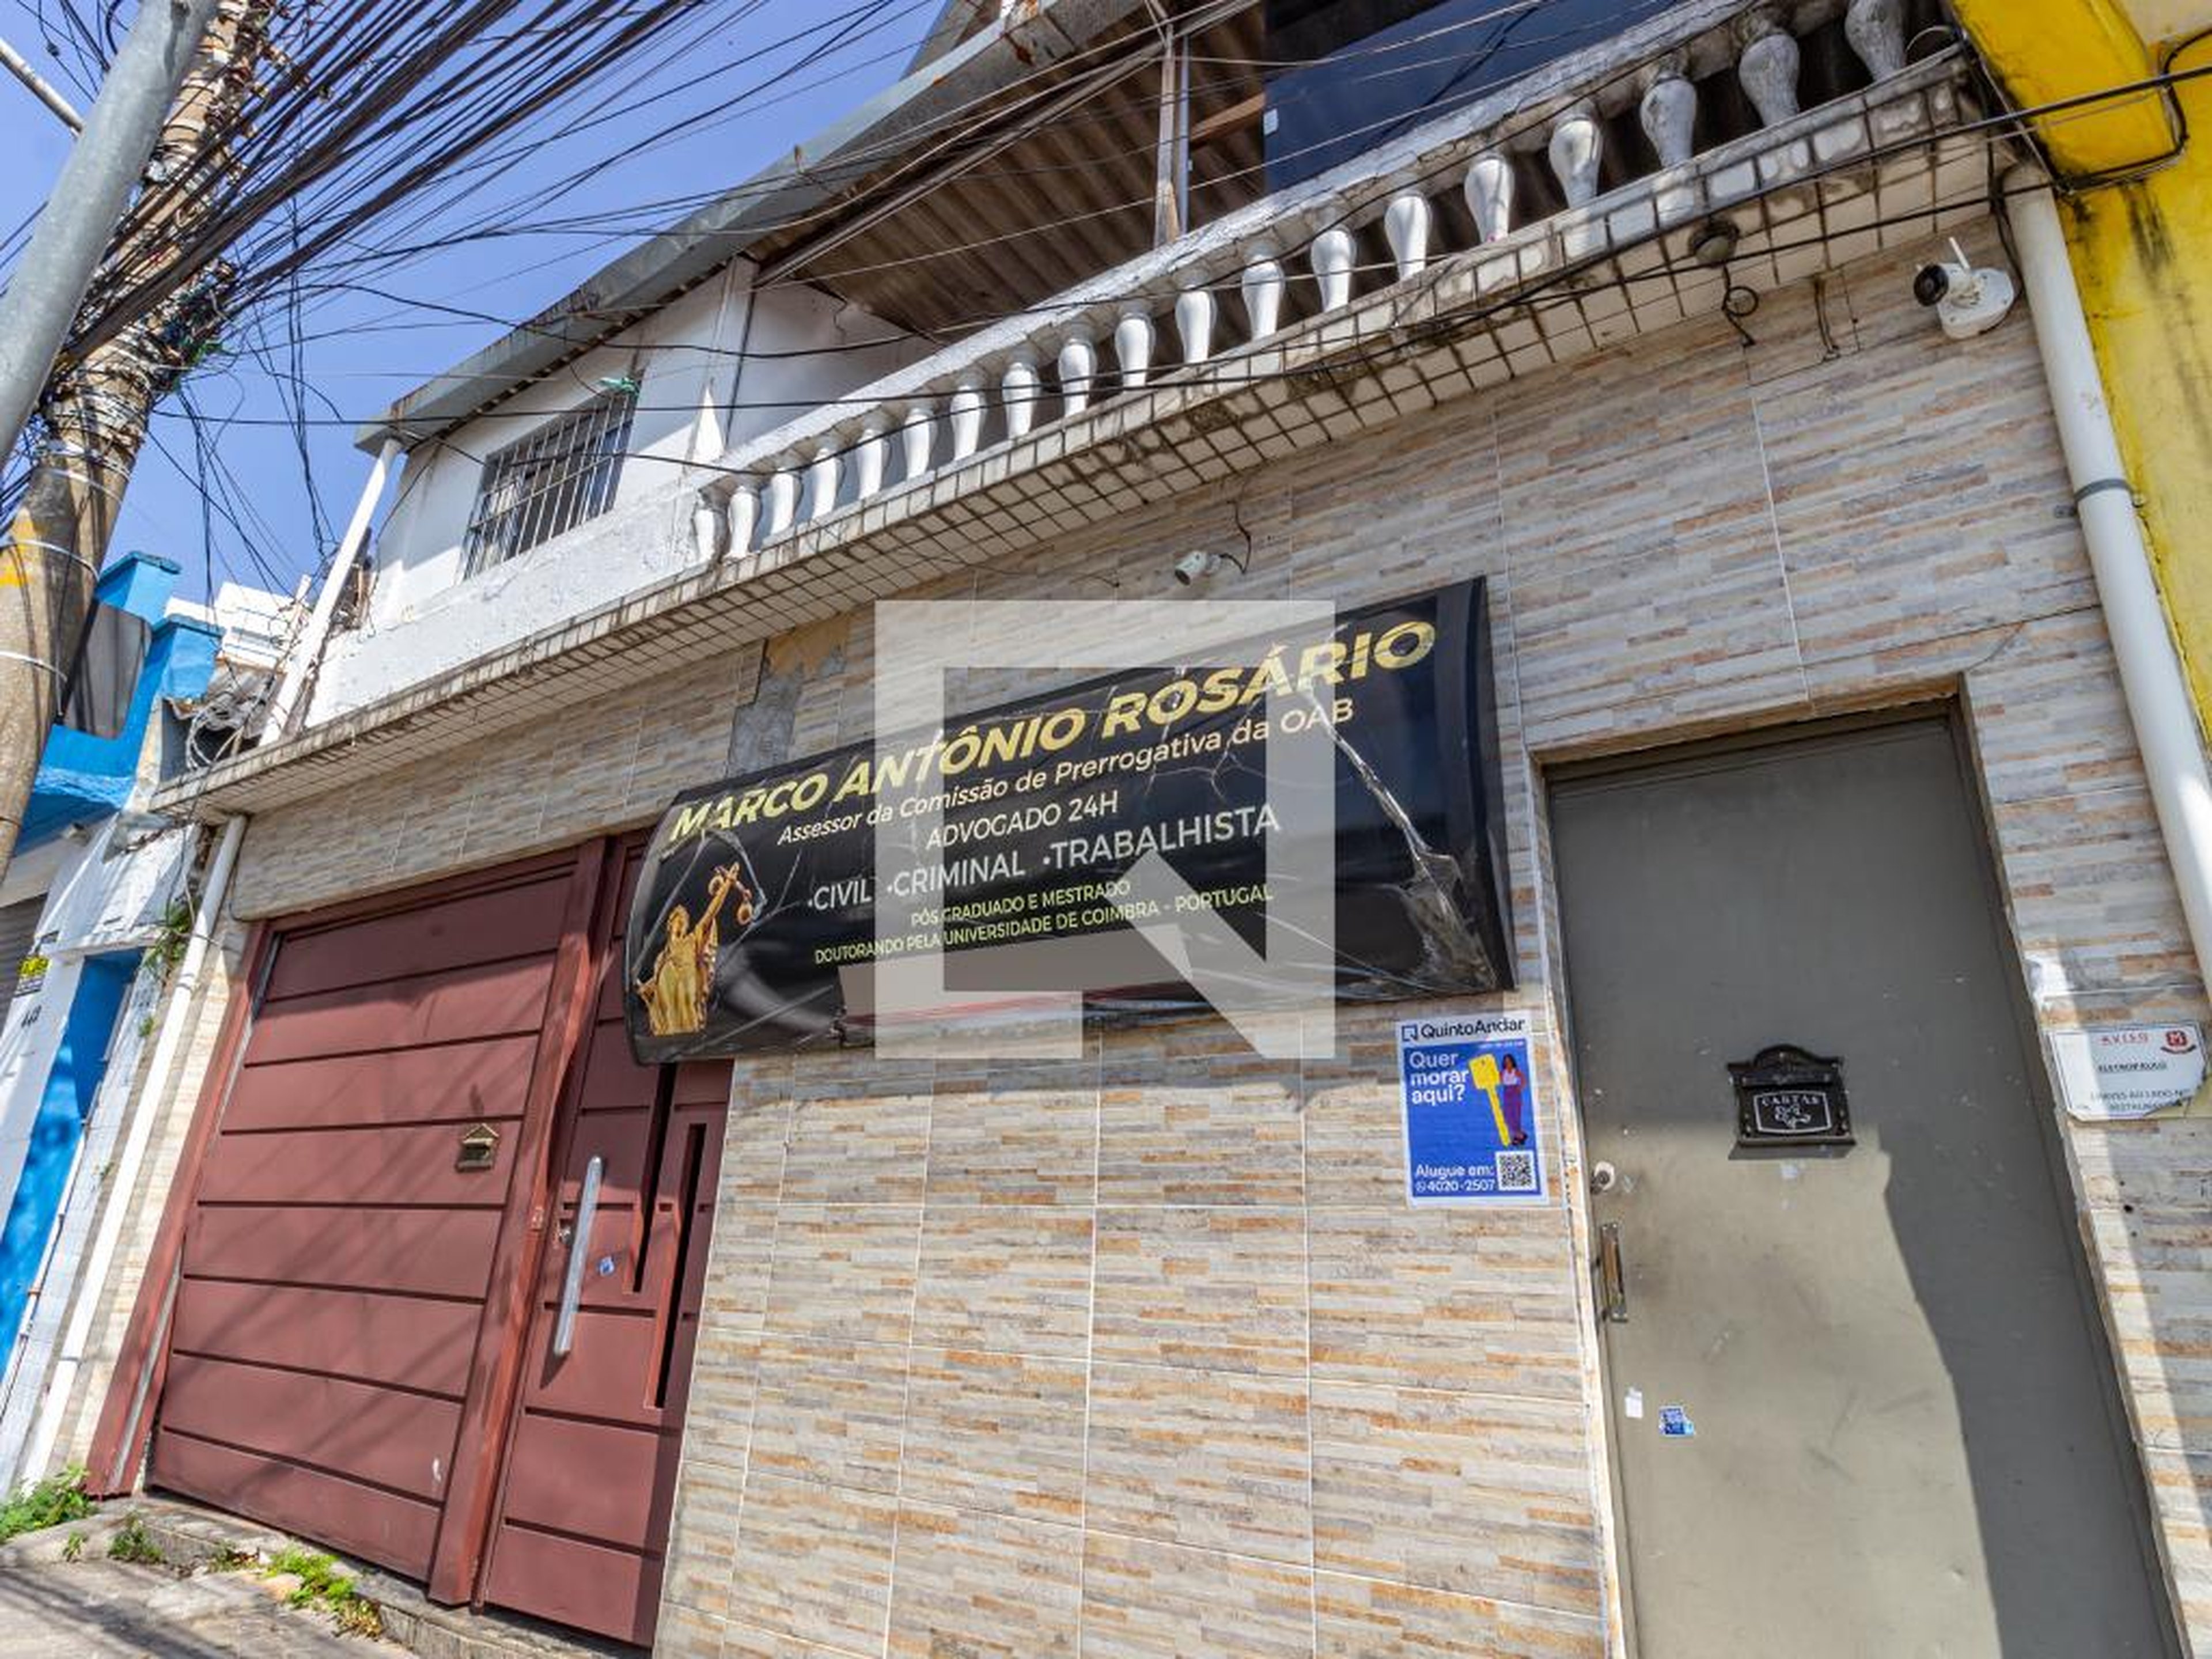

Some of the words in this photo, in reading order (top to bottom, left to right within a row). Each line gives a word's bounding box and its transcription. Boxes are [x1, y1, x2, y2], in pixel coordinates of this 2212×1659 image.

[670, 773, 828, 841] MARCO
[832, 708, 1086, 802] ANTÔNIO
[1101, 621, 1435, 738] ROSÁRIO
[778, 812, 862, 845] Assessor
[866, 803, 893, 825] da
[900, 777, 1007, 818] Comissão
[1016, 770, 1047, 793] de
[1054, 732, 1223, 785] Prerrogativa
[1232, 718, 1271, 744] da
[1280, 698, 1353, 734] OAB
[926, 803, 1061, 850] ADVOGADO
[1069, 790, 1119, 822] 24H
[941, 895, 1025, 922] GRADUADO
[1028, 893, 1037, 910] E
[1042, 880, 1131, 906] MESTRADO
[815, 938, 904, 964] DOUTORANDO
[907, 933, 941, 952] PELA
[944, 914, 1052, 945] UNIVERSIDADE
[1056, 911, 1079, 930] DE
[1084, 901, 1159, 925] COIMBRA
[1175, 884, 1274, 912] PORTUGAL
[1421, 1018, 1525, 1038] QuintoAndar
[1409, 1052, 1459, 1068] Quer
[1411, 1070, 1469, 1086] morar
[1411, 1085, 1466, 1105] aqui?
[1415, 1164, 1466, 1180] Alugue
[1468, 1165, 1495, 1177] em:
